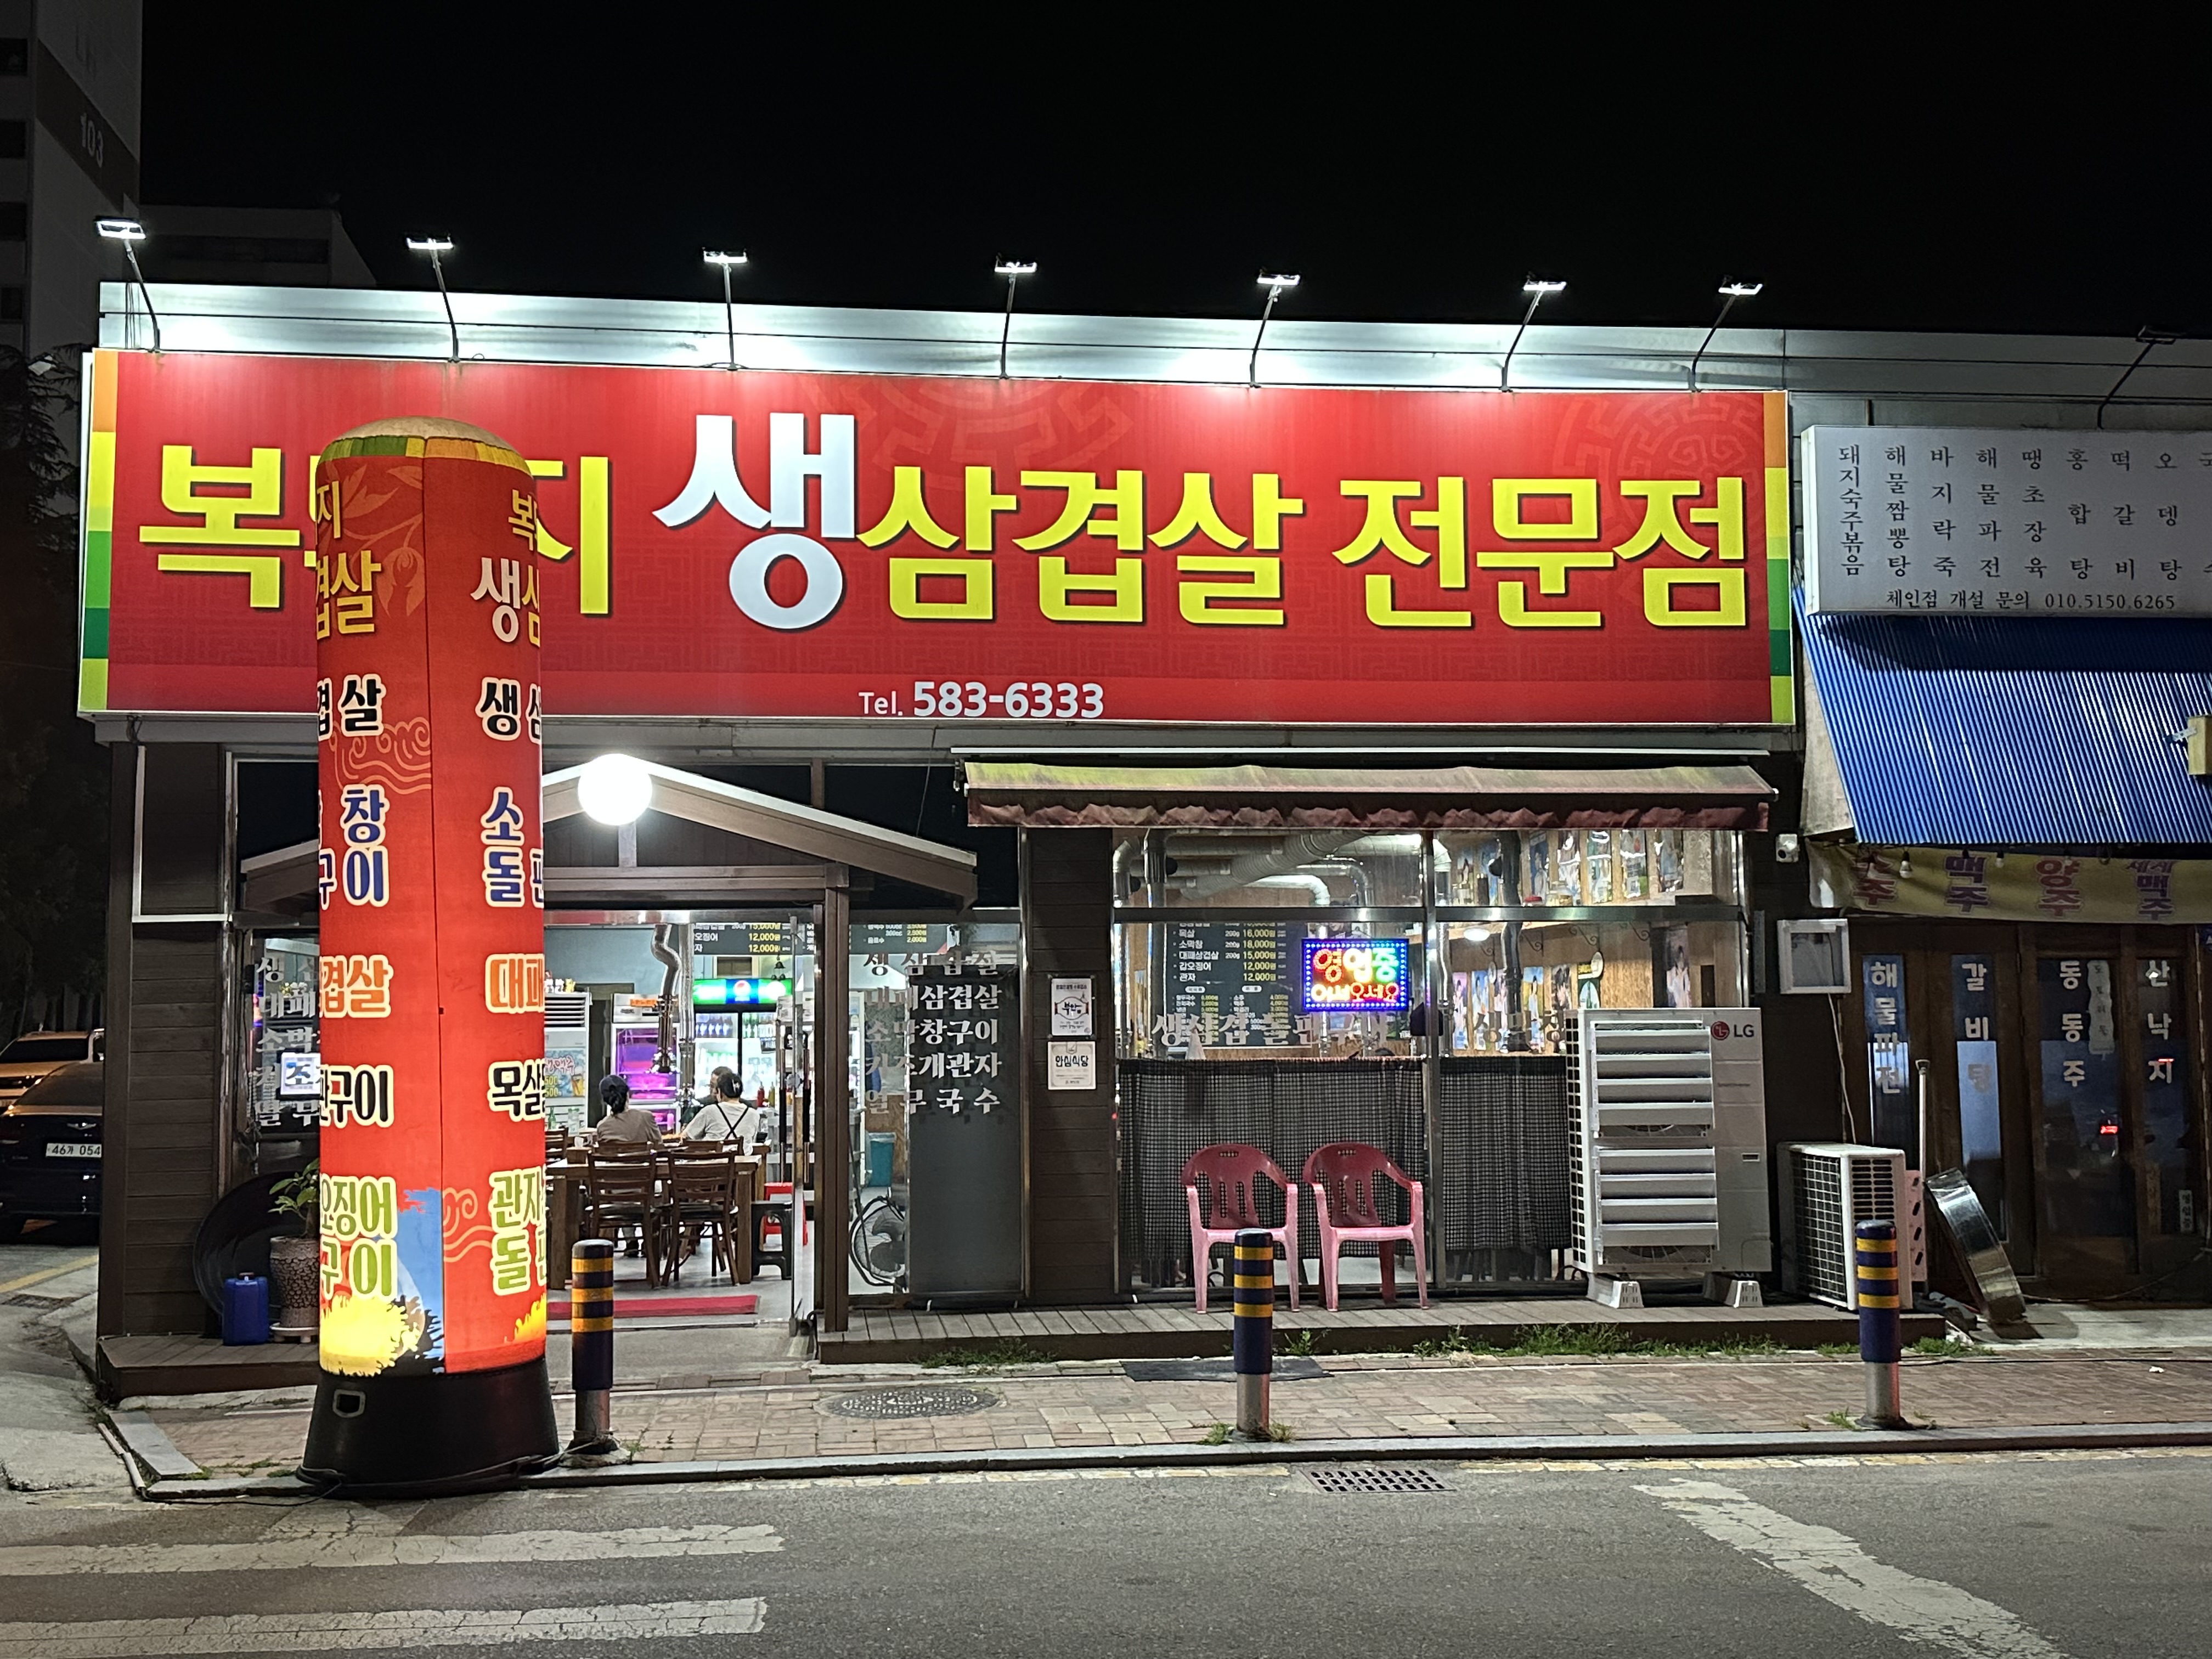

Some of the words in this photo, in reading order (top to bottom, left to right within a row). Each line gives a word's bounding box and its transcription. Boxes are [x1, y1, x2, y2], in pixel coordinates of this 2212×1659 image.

[80, 112, 104, 168] 103
[1839, 444, 1865, 576] 돼지숙주볶음
[1884, 444, 1911, 577] 해물짬뽕탕
[1930, 446, 1957, 578] 바지락죽
[1976, 447, 2002, 578] 해물파전
[2066, 448, 2094, 580] 홍합탕
[2111, 450, 2136, 580] 떡갈비
[2154, 452, 2182, 581] 오뎅탕
[1332, 476, 1746, 627] 전문점
[1886, 589, 1937, 609] 체인점
[1950, 589, 1984, 610] 개설
[1995, 590, 2030, 610] 문의
[2045, 594, 2175, 610] 010.5150.6265
[859, 691, 904, 716] Tel.
[913, 680, 1104, 719] 583-6333
[1944, 855, 1990, 913] 맥주
[2035, 856, 2083, 917] 양주
[748, 933, 781, 941] 12,000원
[1180, 962, 1211, 971] 갑오징어
[1243, 962, 1276, 971] 12,000원
[1243, 951, 1276, 960] 15,000원
[1313, 947, 1399, 983] 영업중
[1243, 973, 1276, 982] 12,000원
[1311, 982, 1400, 1003] 어서오세요
[1734, 1024, 1754, 1037] LG
[1870, 960, 1900, 1094] 해물파전
[2060, 961, 2085, 1087] 동동주
[2147, 961, 2171, 1084] 산낙지
[1055, 1055, 1089, 1068] 안심식당
